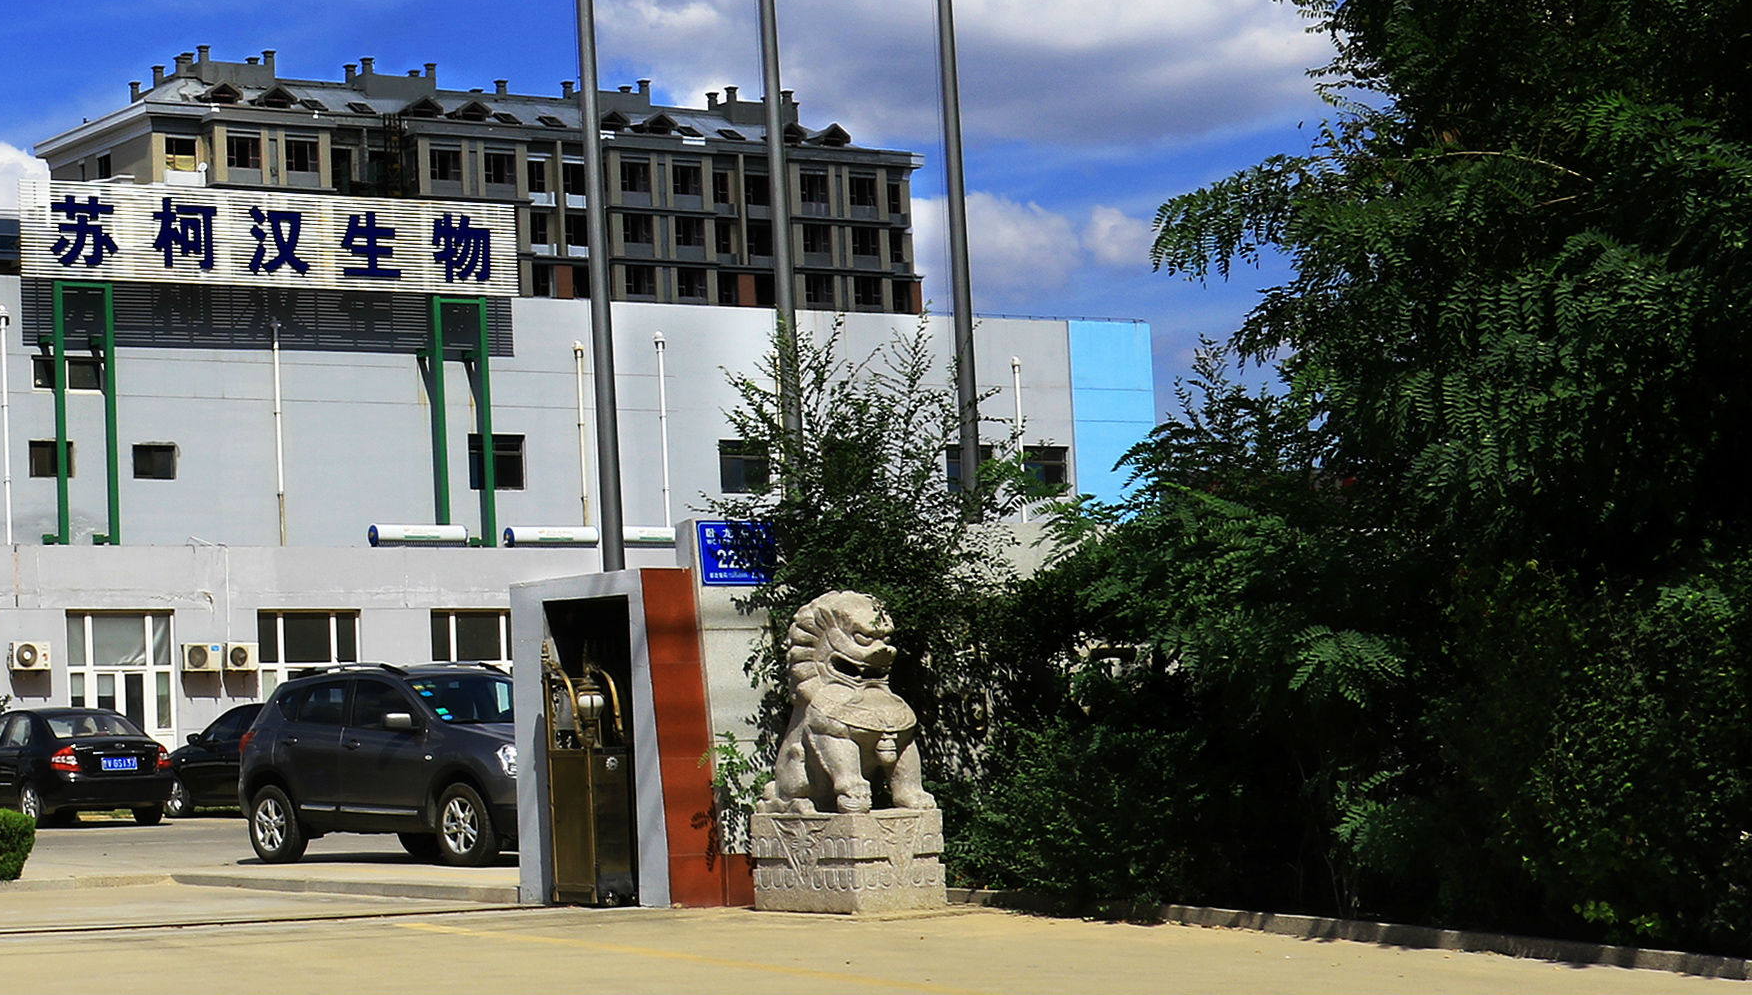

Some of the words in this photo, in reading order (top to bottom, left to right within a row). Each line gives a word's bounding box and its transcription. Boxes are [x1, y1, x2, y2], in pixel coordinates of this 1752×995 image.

[51, 195, 491, 283] 苏柯汉生物
